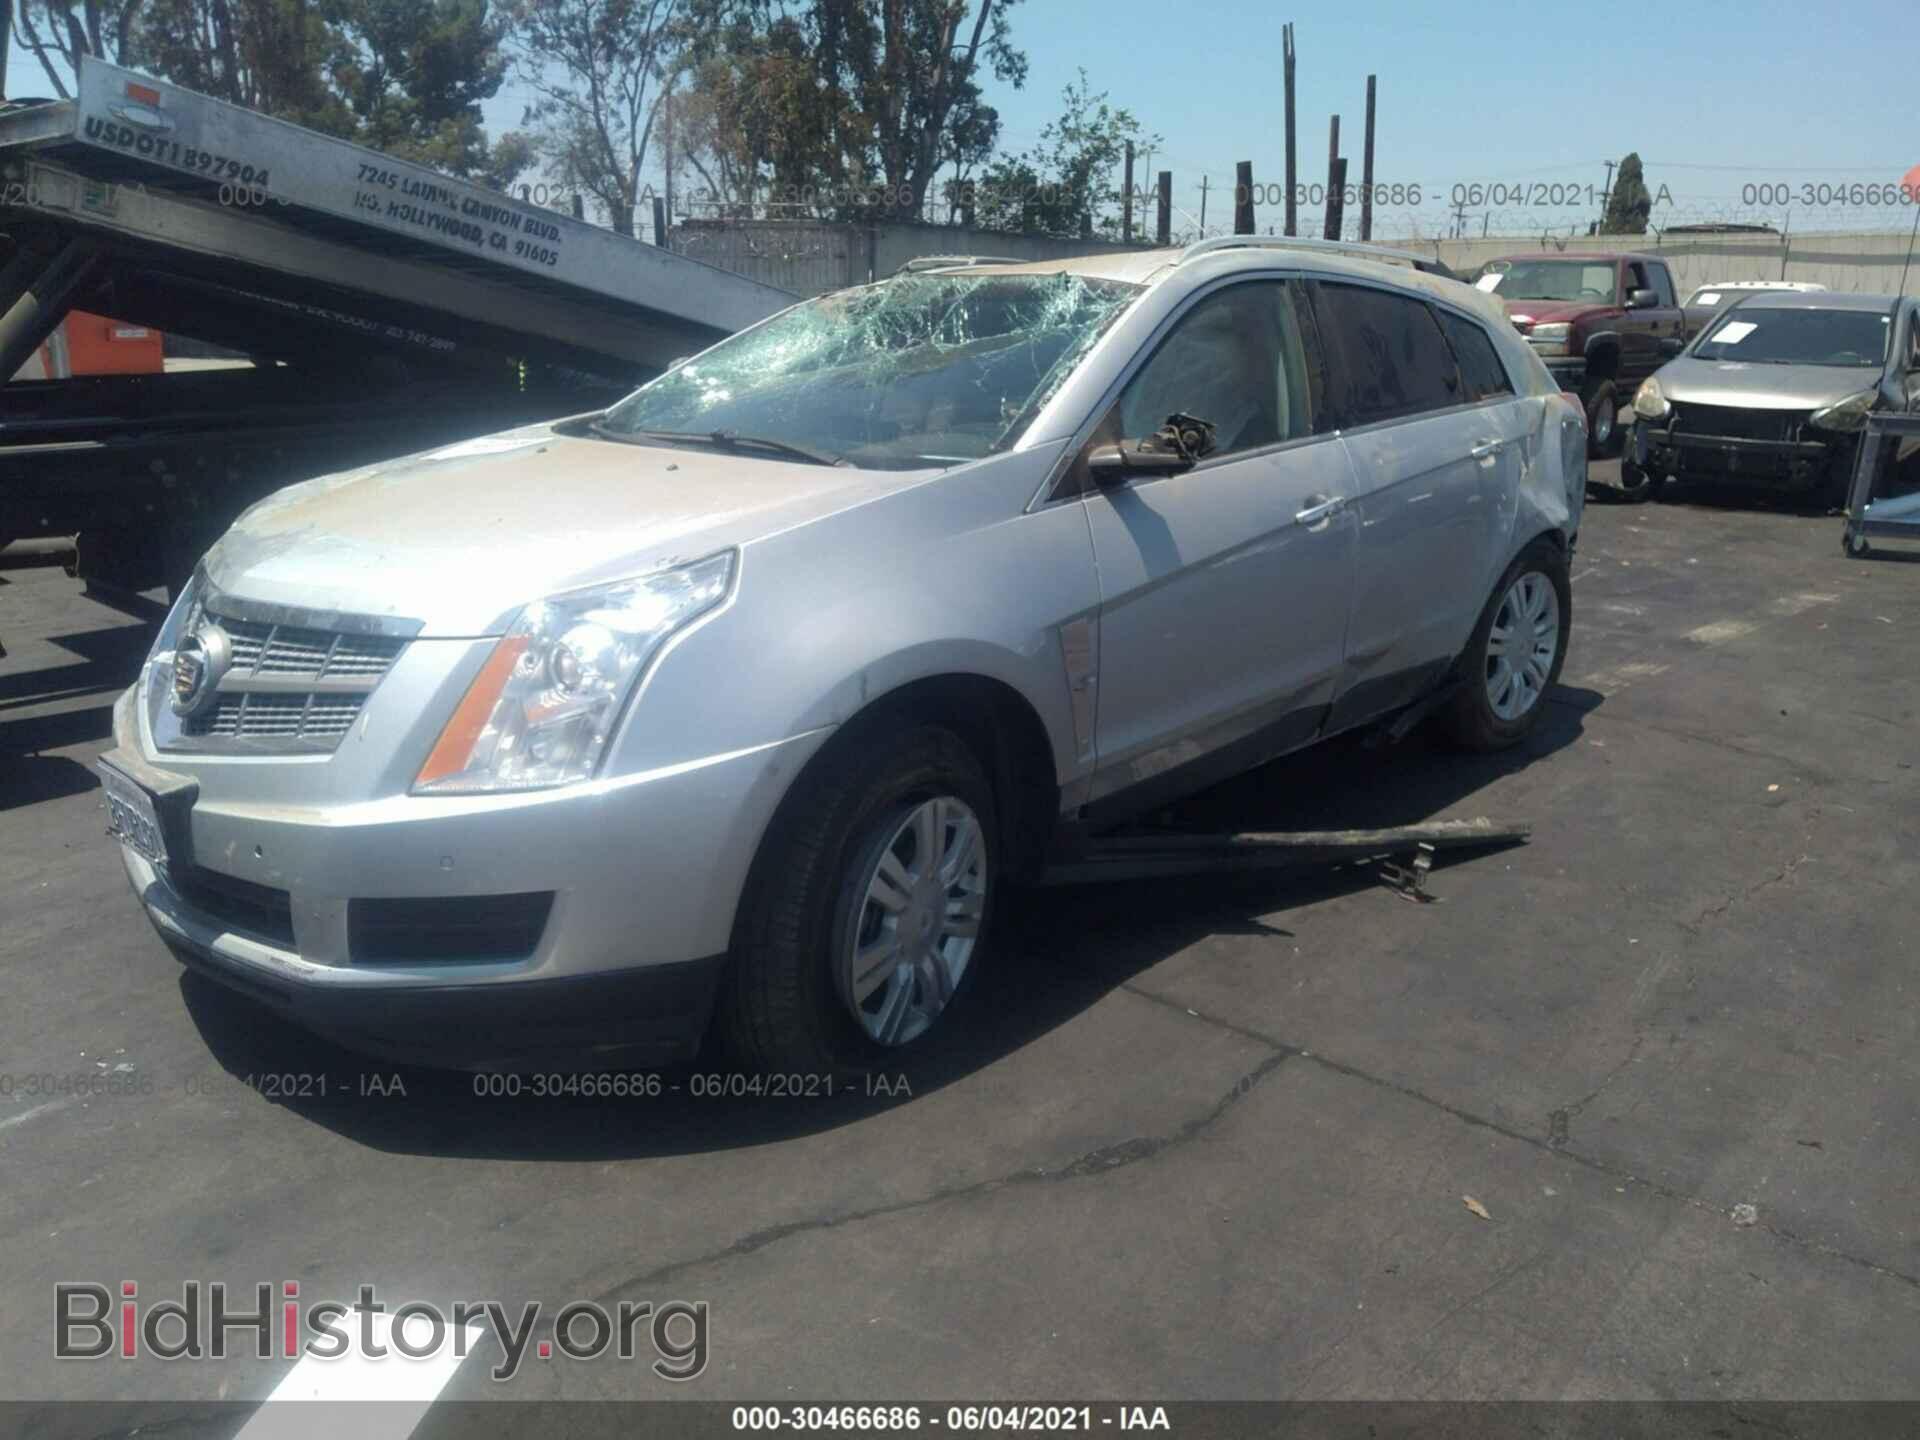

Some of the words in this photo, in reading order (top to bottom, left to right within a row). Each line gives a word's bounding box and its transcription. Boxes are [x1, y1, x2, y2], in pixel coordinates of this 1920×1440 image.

[357, 163, 399, 191] 7245
[460, 196, 523, 230] CANYON
[523, 217, 563, 244] BLVD.
[386, 199, 486, 249] HOLLYWOOD,
[489, 231, 508, 252] CA
[513, 239, 560, 267] 91605
